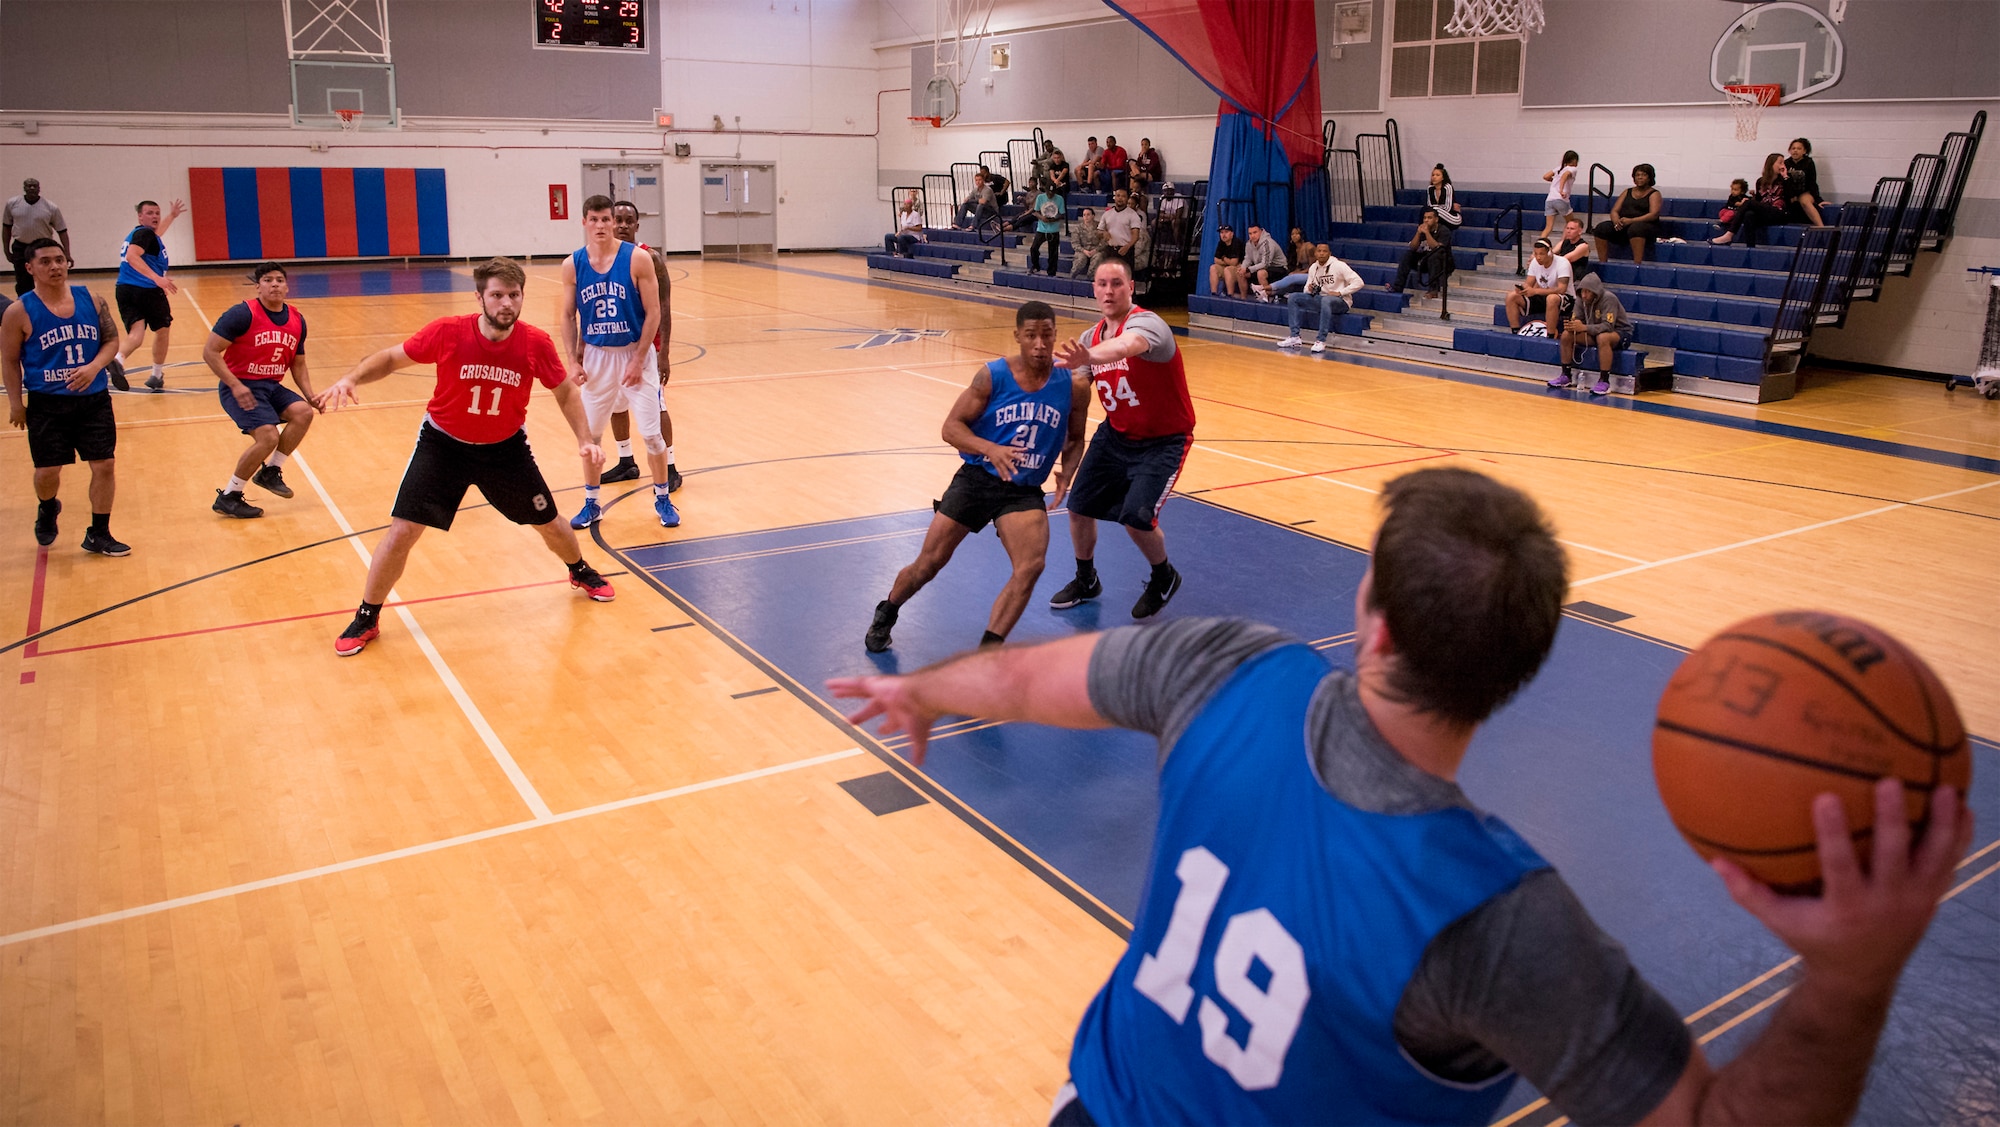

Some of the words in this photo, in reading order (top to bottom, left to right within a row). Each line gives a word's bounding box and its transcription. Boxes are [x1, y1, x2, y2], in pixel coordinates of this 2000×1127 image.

[620, 2, 639, 17] 29
[552, 23, 562, 39] 2
[631, 27, 640, 43] 3
[581, 282, 608, 305] EGLIN
[608, 281, 626, 300] AFB
[595, 298, 618, 319] 25
[39, 324, 74, 351] EGLIN
[77, 324, 98, 341] AFB
[254, 330, 281, 347] EGLIN
[281, 332, 297, 351] AFB
[64, 343, 85, 365] 11
[270, 347, 284, 363] 5
[459, 364, 521, 387] CRUSADERS
[467, 385, 503, 416] 11
[1096, 375, 1140, 412] 34
[995, 402, 1035, 427] EGLIN
[1034, 403, 1061, 429] AFB
[1010, 424, 1039, 449] 21
[1132, 845, 1312, 1092] 19
